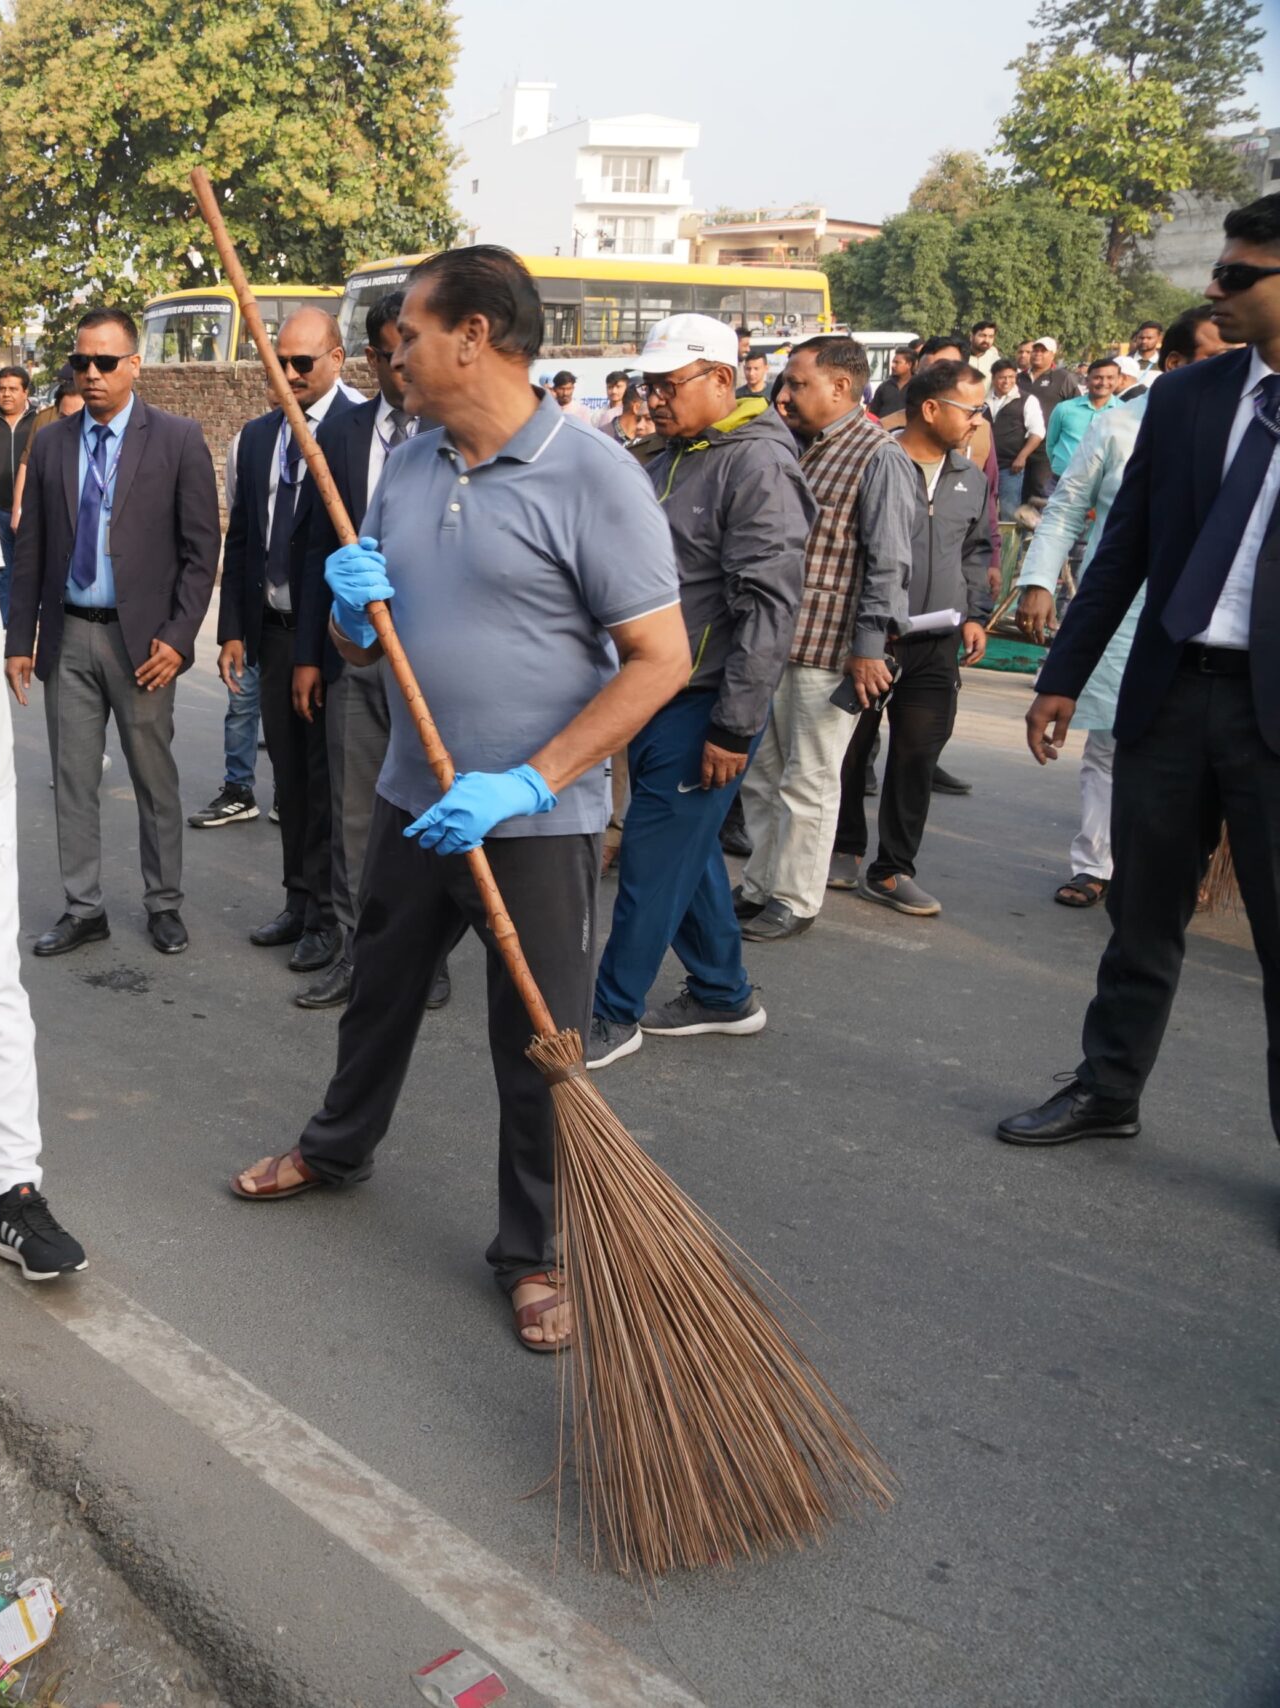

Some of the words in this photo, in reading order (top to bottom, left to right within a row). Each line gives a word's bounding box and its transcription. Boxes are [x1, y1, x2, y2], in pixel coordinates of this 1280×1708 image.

[372, 274, 398, 286] INSTITUTE
[398, 274, 407, 283] OF
[183, 304, 204, 313] MEDICAL
[204, 304, 231, 313] SCIENCES
